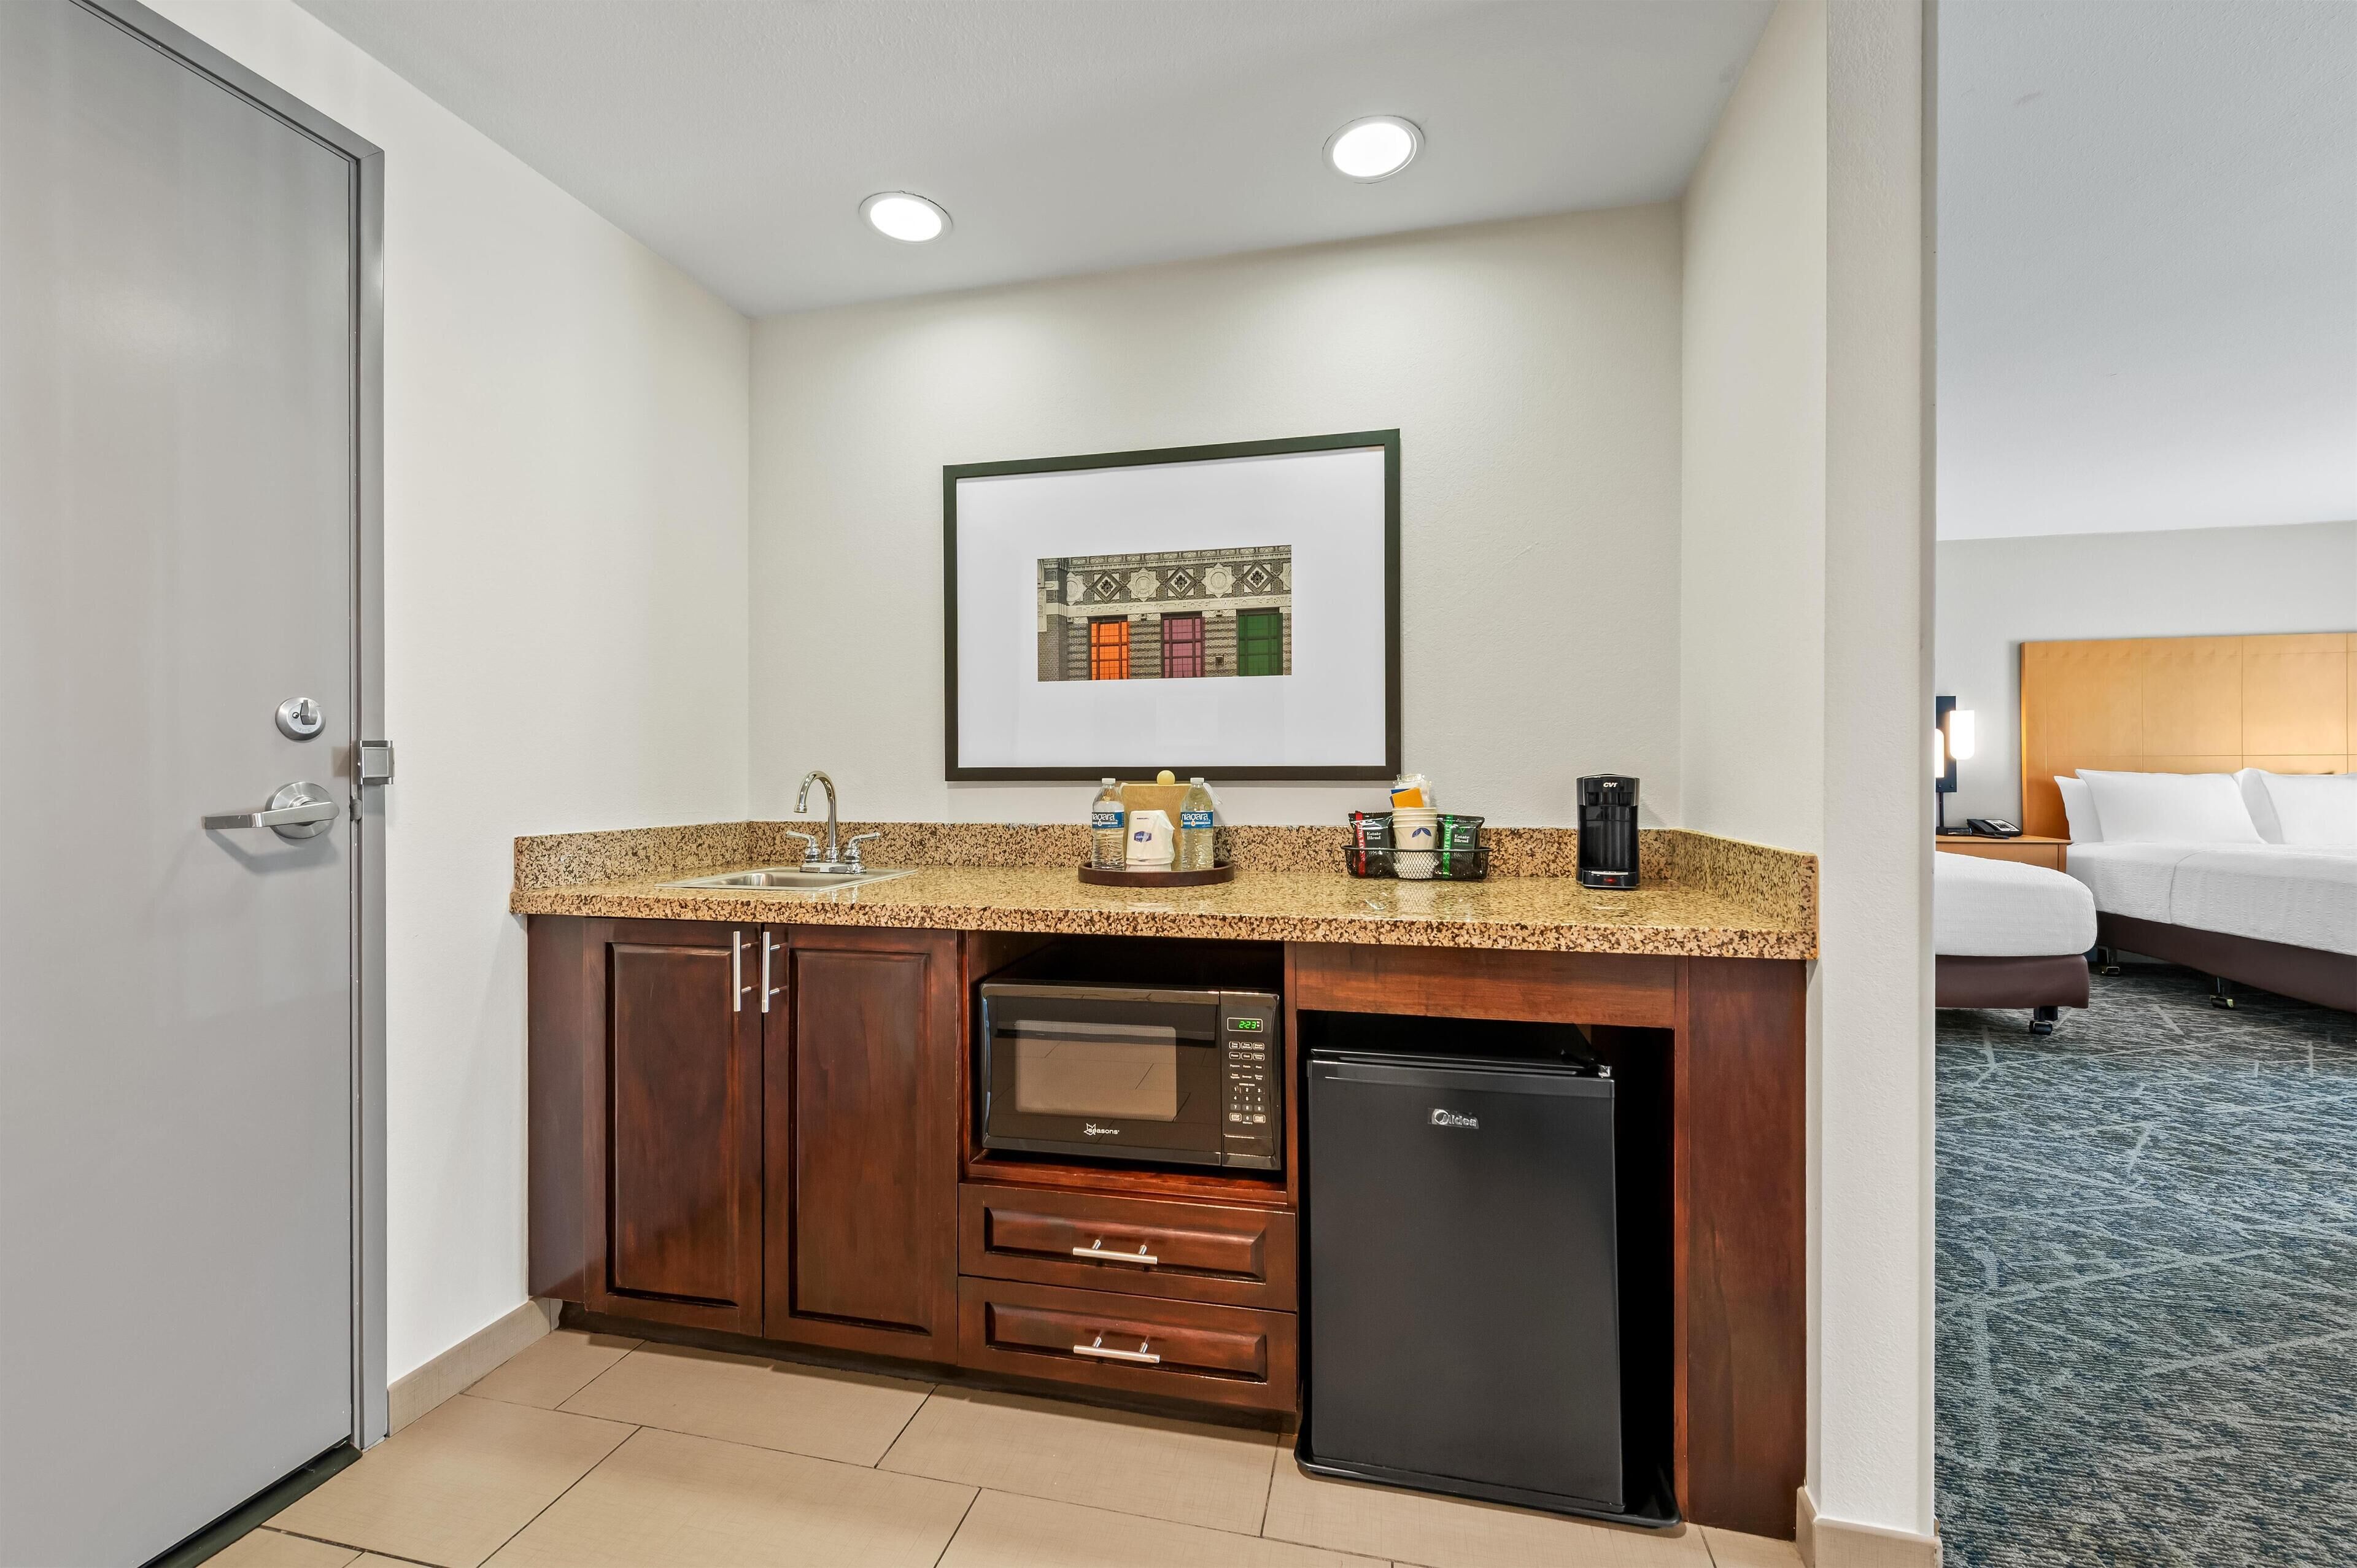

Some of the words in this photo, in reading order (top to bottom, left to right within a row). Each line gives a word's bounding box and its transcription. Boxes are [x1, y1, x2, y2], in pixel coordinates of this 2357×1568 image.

[1082, 605, 1142, 615] DEDICATED
[1174, 600, 1210, 610] THOSE
[1220, 598, 1248, 608] WHO
[1182, 813, 1209, 826] niagara
[1239, 1021, 1256, 1029] 2:23
[1438, 1112, 1477, 1127] Midea
